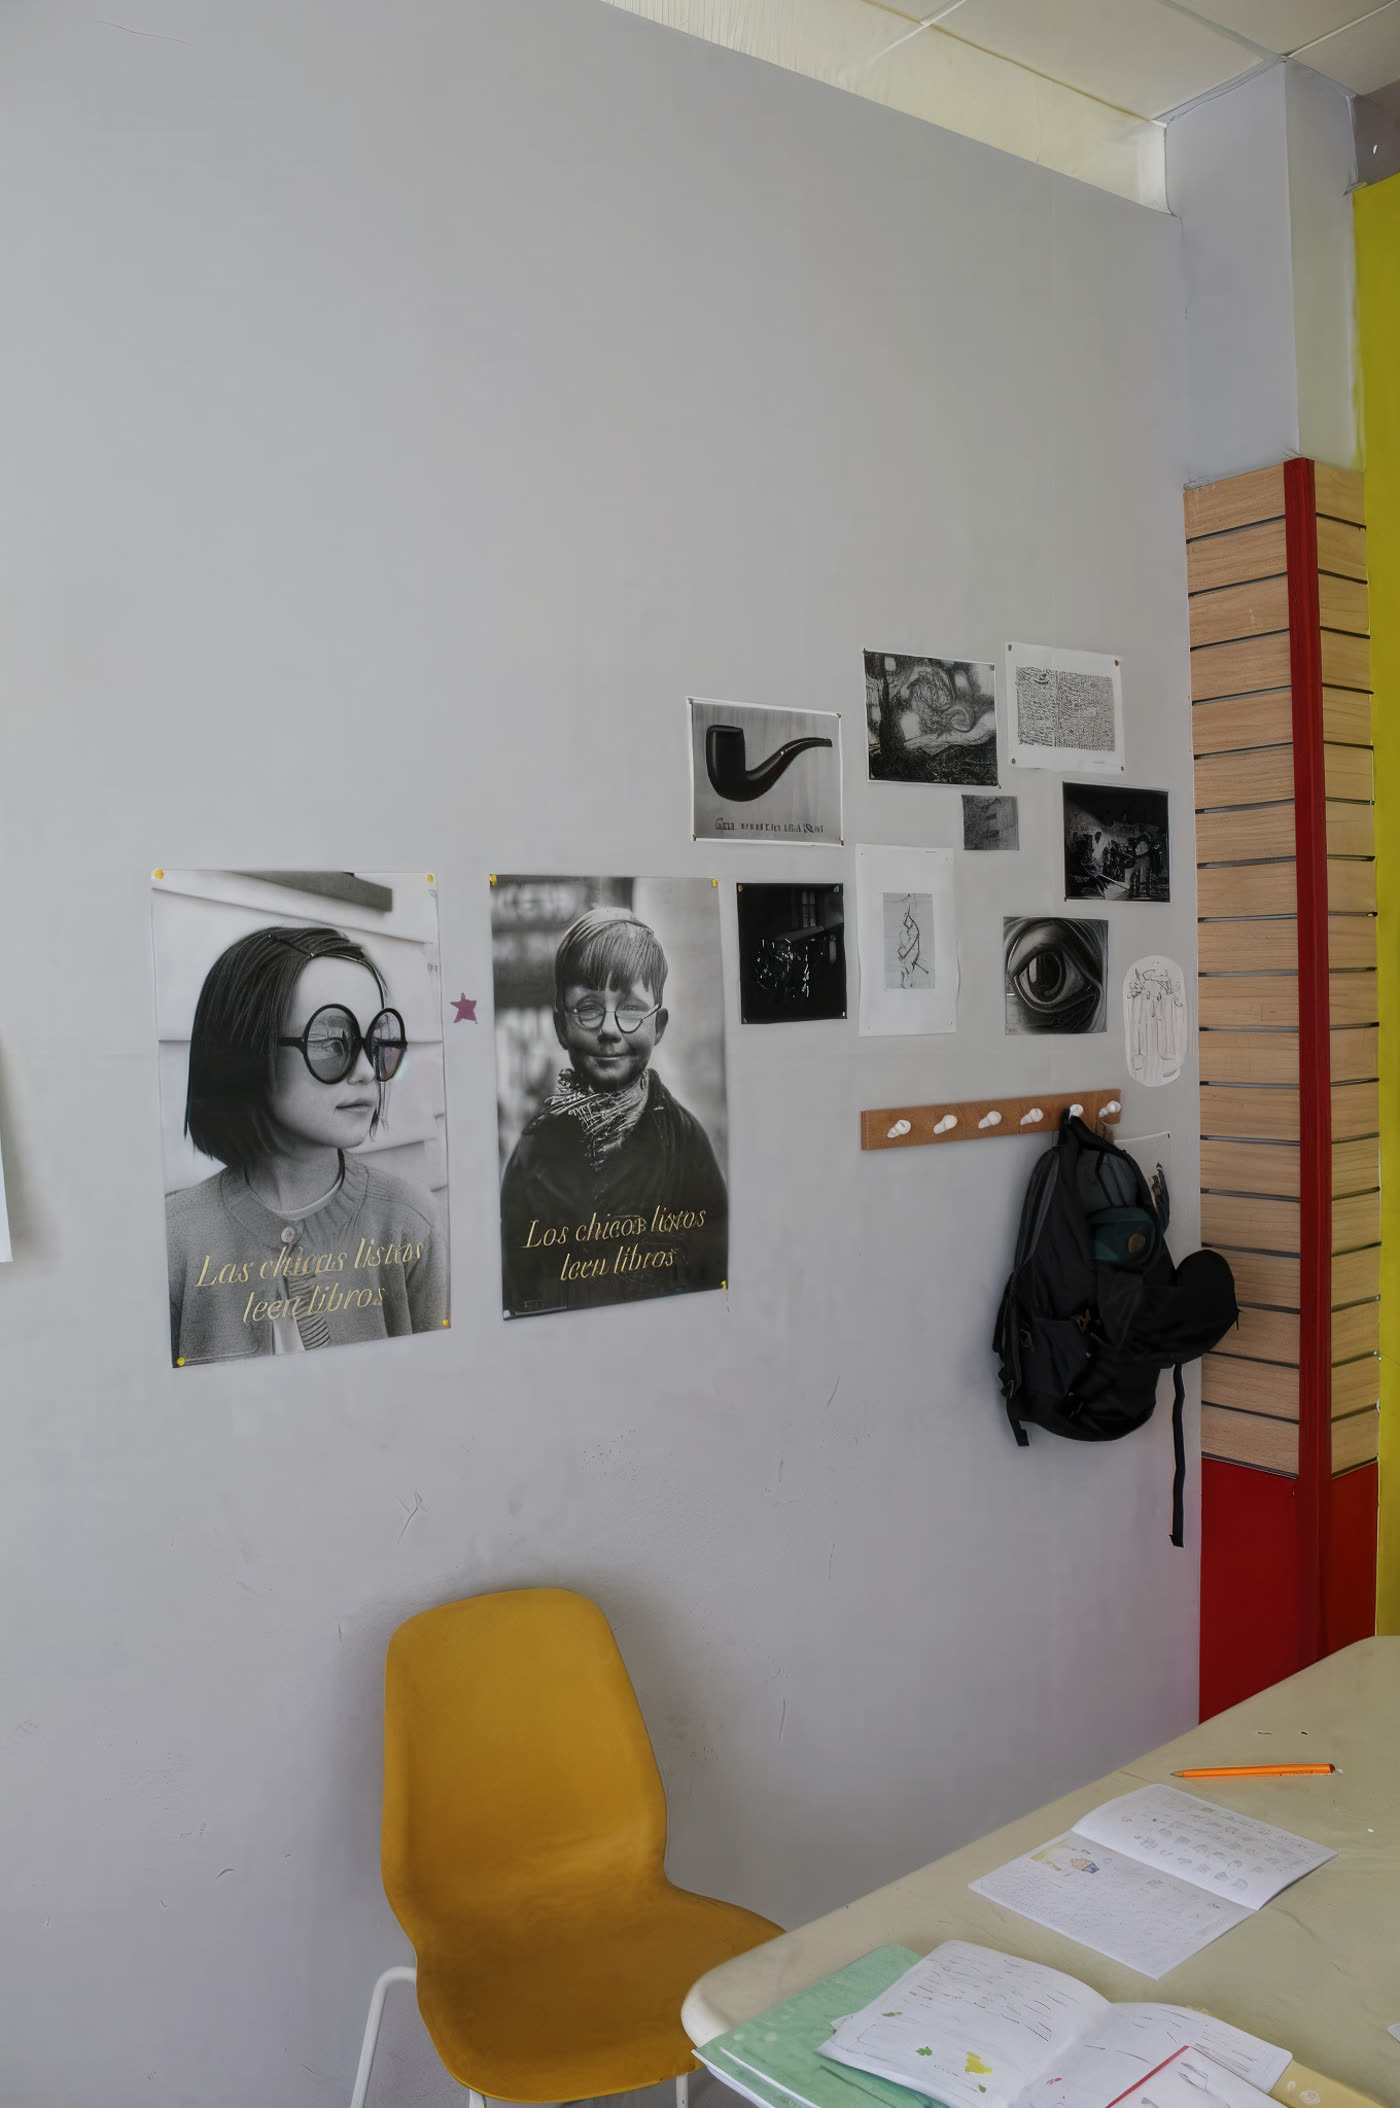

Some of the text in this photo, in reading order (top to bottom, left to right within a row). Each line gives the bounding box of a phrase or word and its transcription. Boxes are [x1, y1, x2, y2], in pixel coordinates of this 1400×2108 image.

[521, 1219, 569, 1248] Los
[196, 1255, 253, 1288] Las
[560, 1243, 677, 1281] leen libros
[243, 1282, 386, 1325] leen libros
